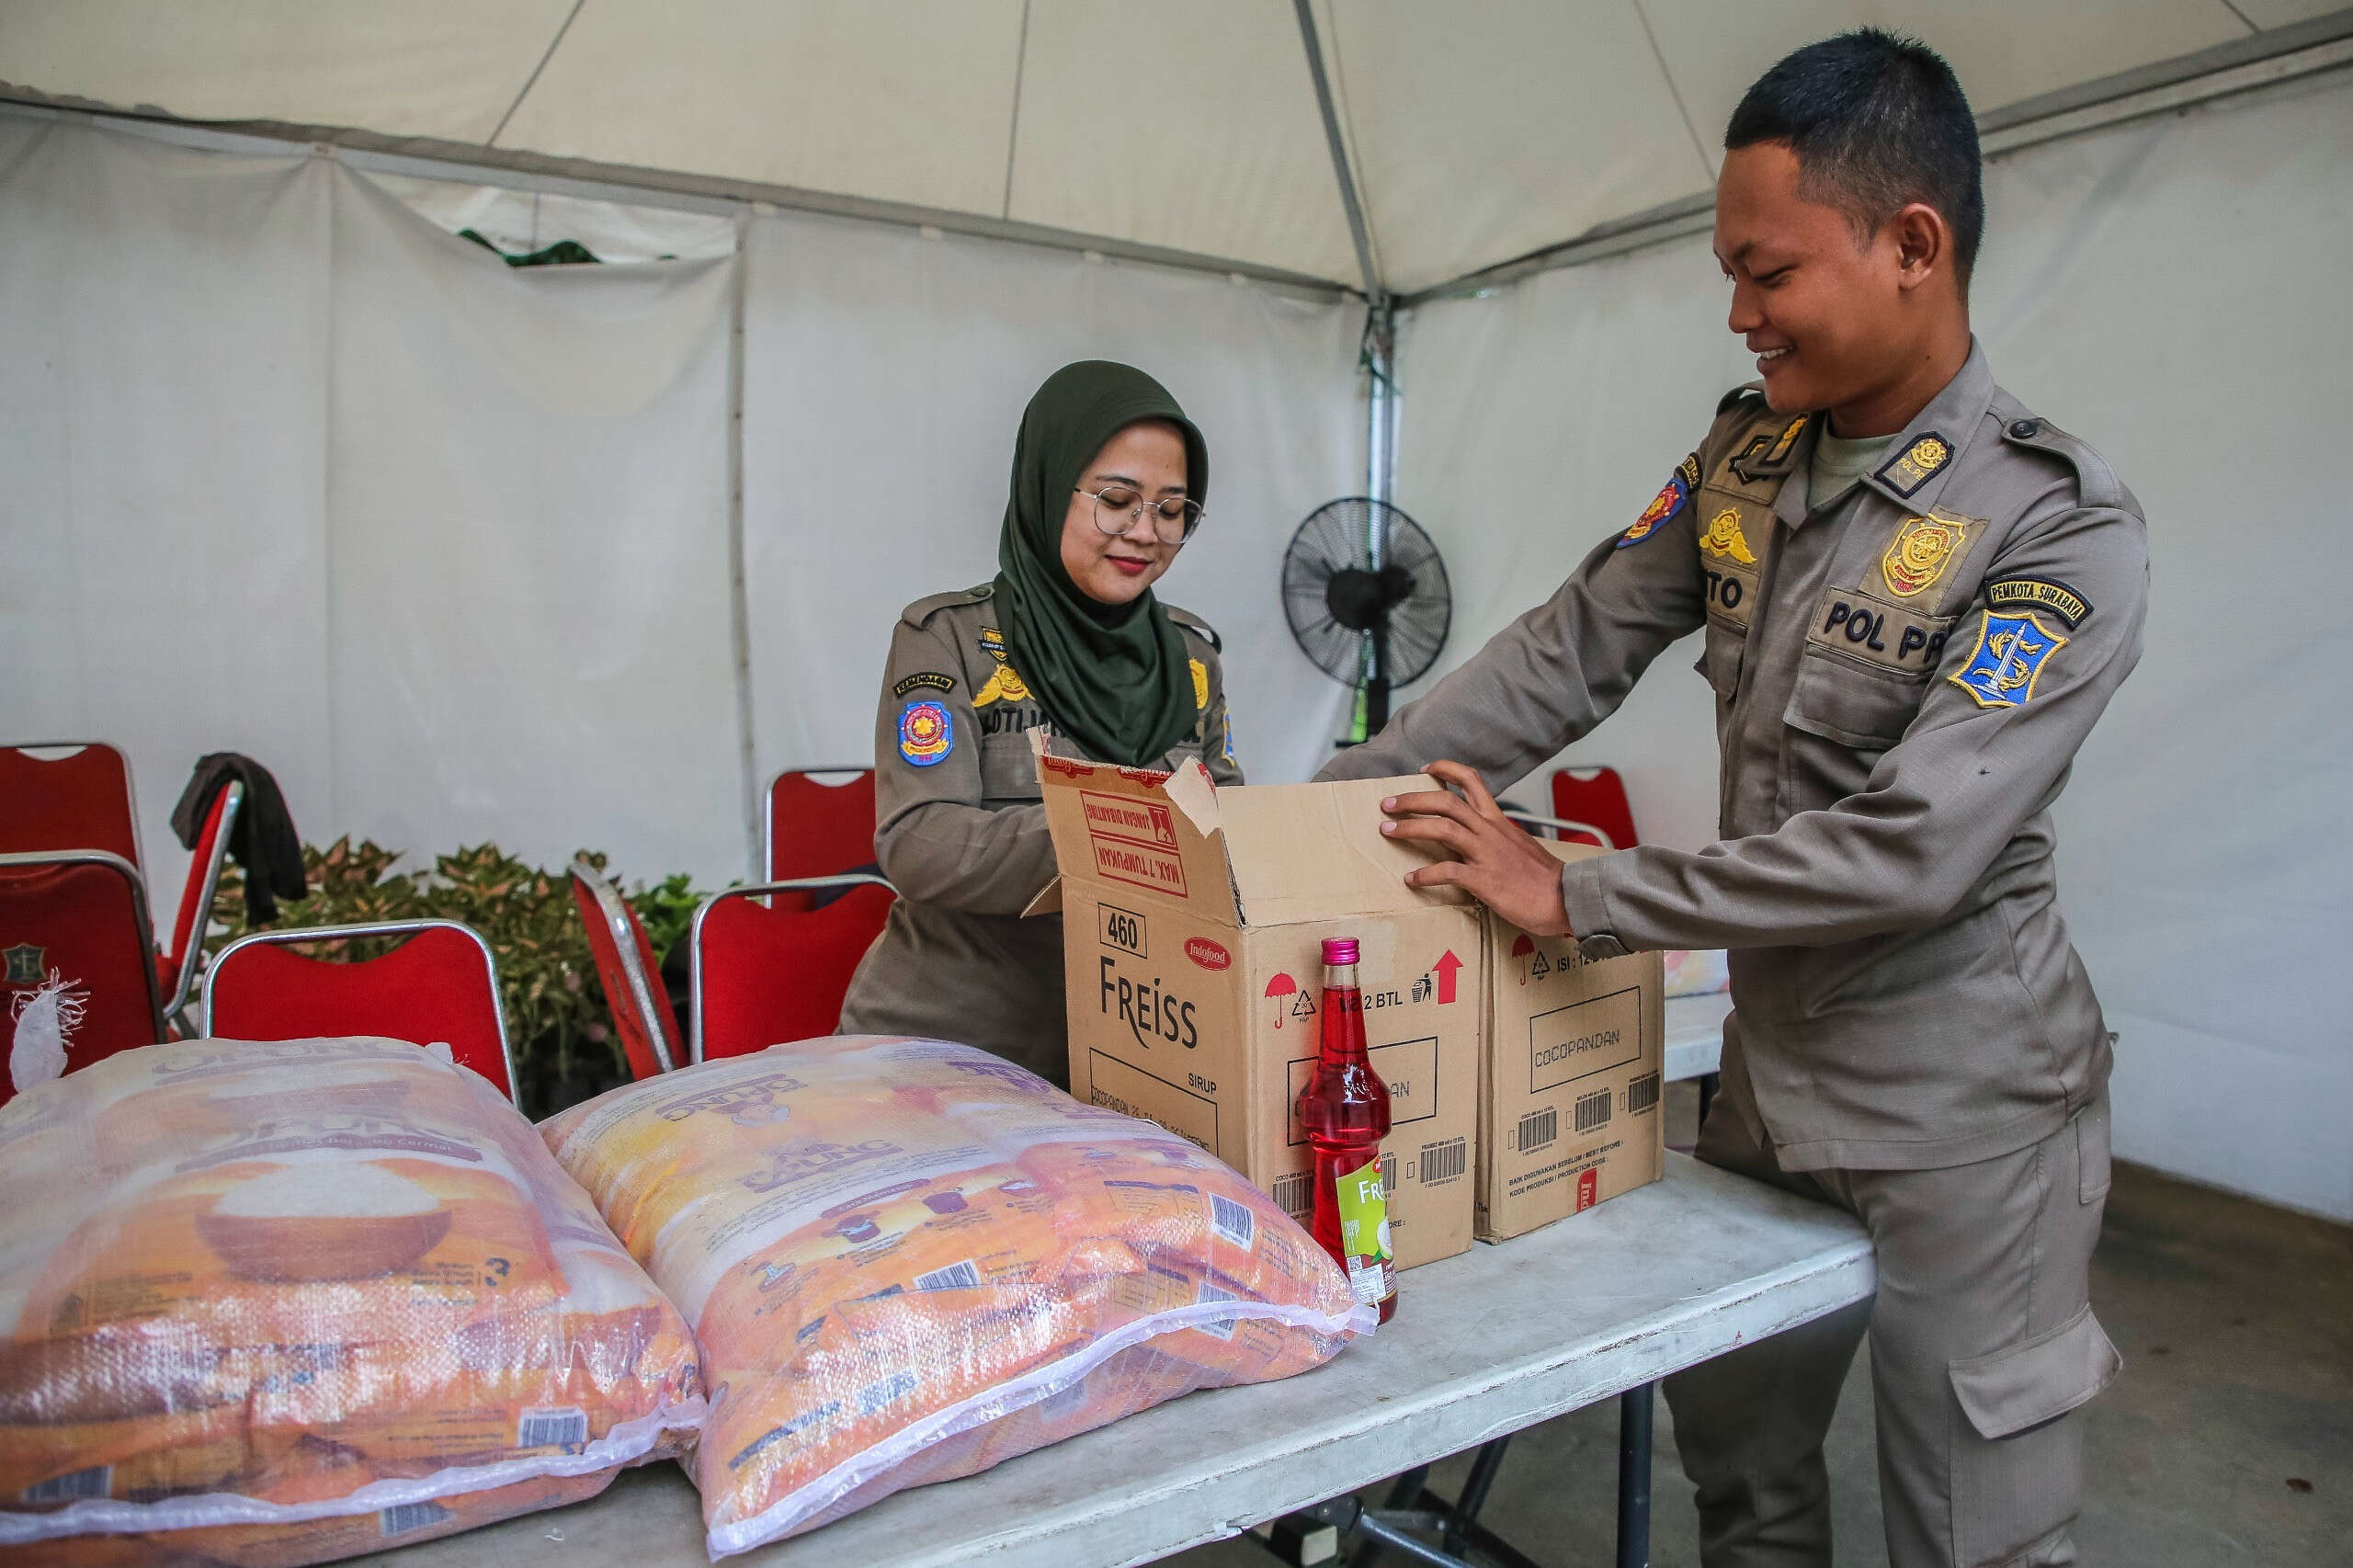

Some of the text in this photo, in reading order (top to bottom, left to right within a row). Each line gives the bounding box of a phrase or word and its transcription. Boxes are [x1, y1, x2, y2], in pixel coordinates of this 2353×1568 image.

[1991, 582, 2085, 620] PEMKOTA SURABAYA
[1824, 601, 1885, 653] POL
[1086, 802, 1150, 830] JANGAN DIBANTING
[1097, 846, 1180, 885] MAX. 7 TUMPUKAN
[1108, 912, 1139, 950] 460
[1189, 941, 1226, 965] Indofood
[1557, 955, 1570, 972] ISI
[1376, 991, 1404, 1009] BTL
[1535, 1028, 1620, 1068] COCOPANDAN
[1188, 1072, 1218, 1096] SIRUP
[1508, 1175, 1523, 1187] BAIK
[1523, 1164, 1556, 1182] DIGUNAKAN
[1557, 1153, 1583, 1169] SEBELUM
[1585, 1147, 1599, 1160] BEST
[1599, 1140, 1620, 1153] BEFORE
[1509, 1187, 1525, 1198] KODE
[1526, 1176, 1554, 1193] PRODUKSI
[1558, 1163, 1591, 1182] PRODUCTION
